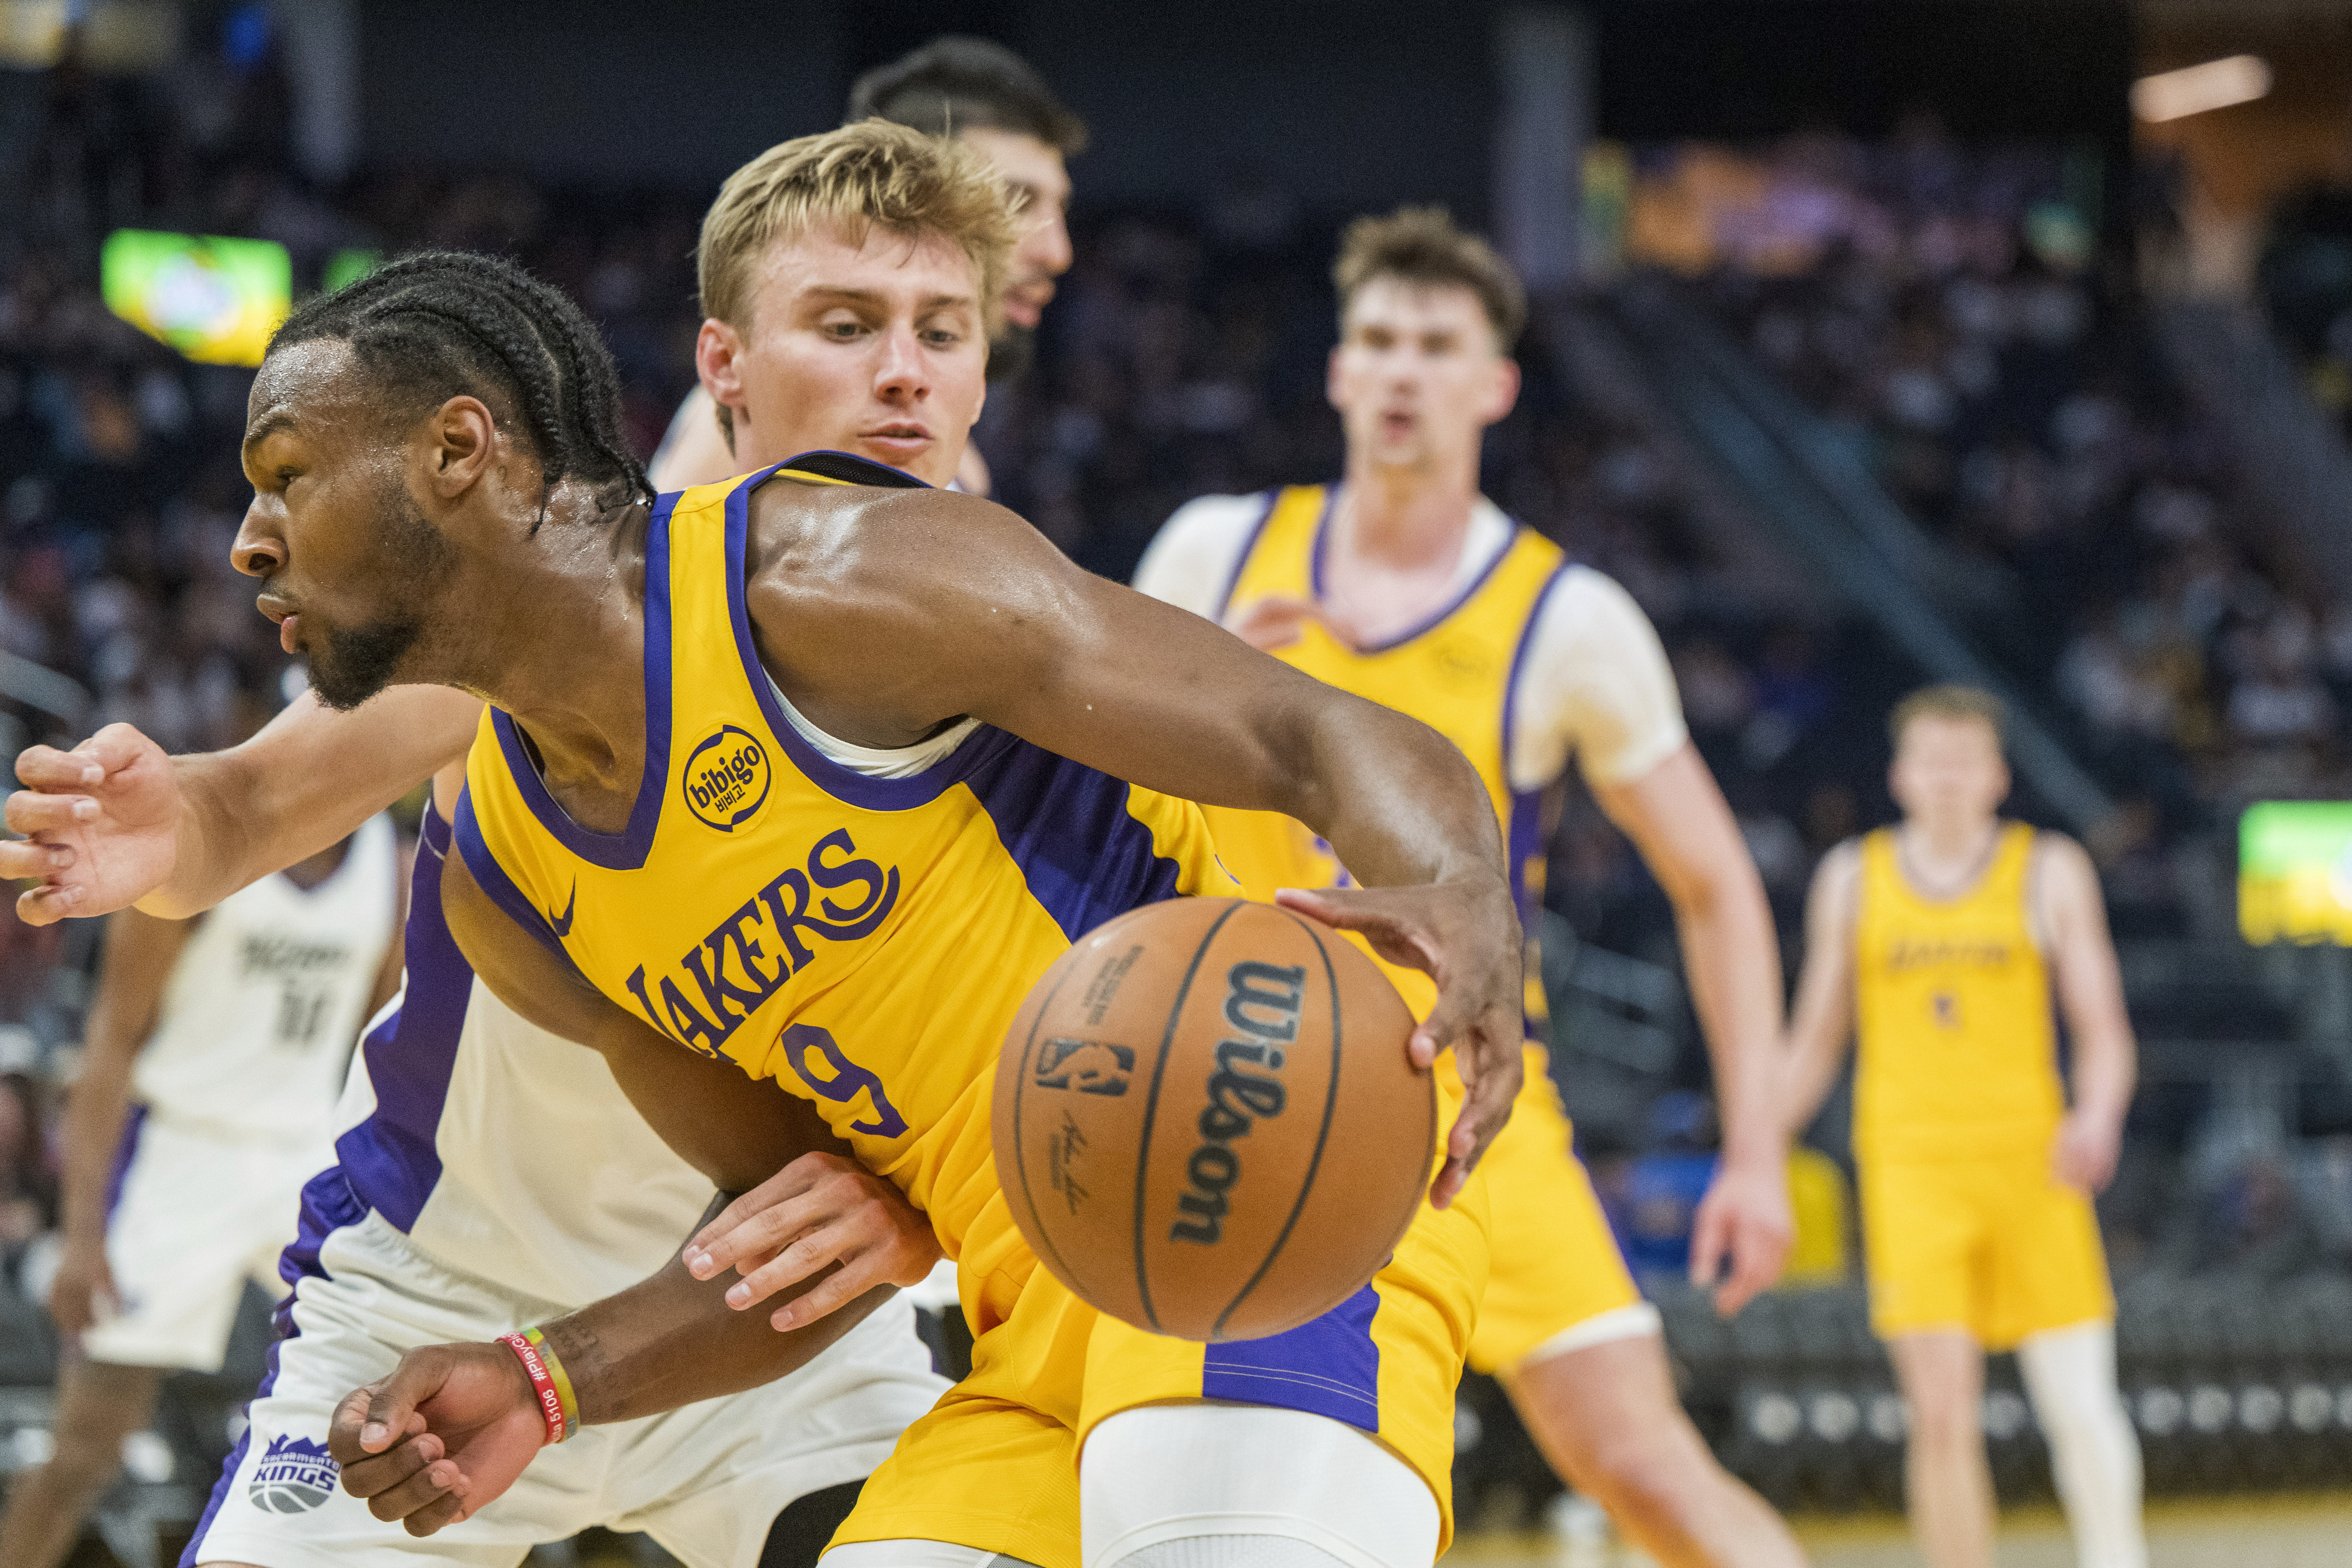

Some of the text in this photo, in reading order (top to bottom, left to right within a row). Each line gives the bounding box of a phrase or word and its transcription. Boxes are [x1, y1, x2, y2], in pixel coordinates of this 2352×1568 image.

[689, 745, 760, 809] bibigo
[714, 783, 746, 813] 비비고
[780, 1022, 910, 1139] 9
[1168, 959, 1308, 1246] Wilson
[542, 1389, 561, 1422] 5106
[253, 1465, 336, 1492] KINGS
